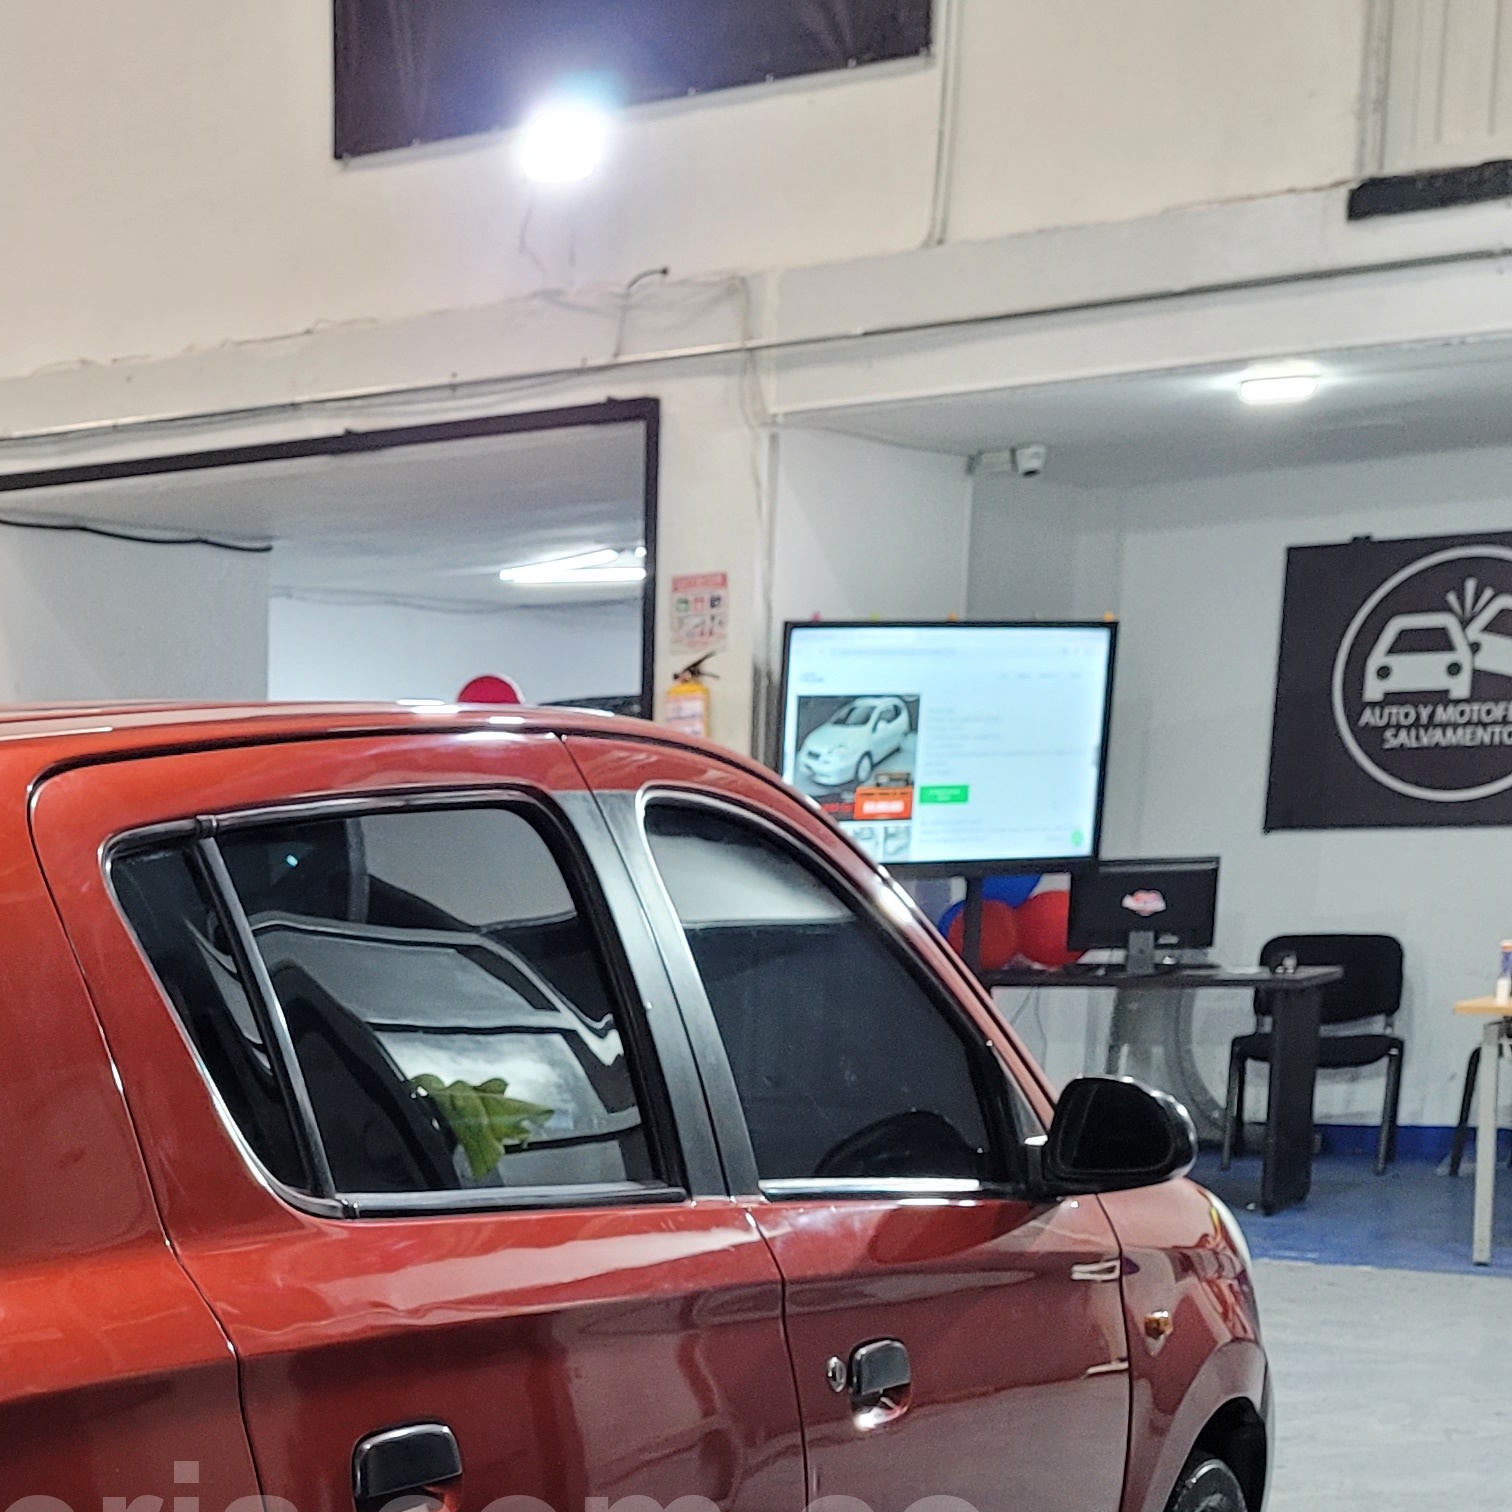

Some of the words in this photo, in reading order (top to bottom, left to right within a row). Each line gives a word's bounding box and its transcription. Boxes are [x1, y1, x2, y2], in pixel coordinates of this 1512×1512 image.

[1357, 703, 1417, 728] AUTO
[1417, 703, 1434, 725] Y
[1433, 701, 1512, 725] MOTOF
